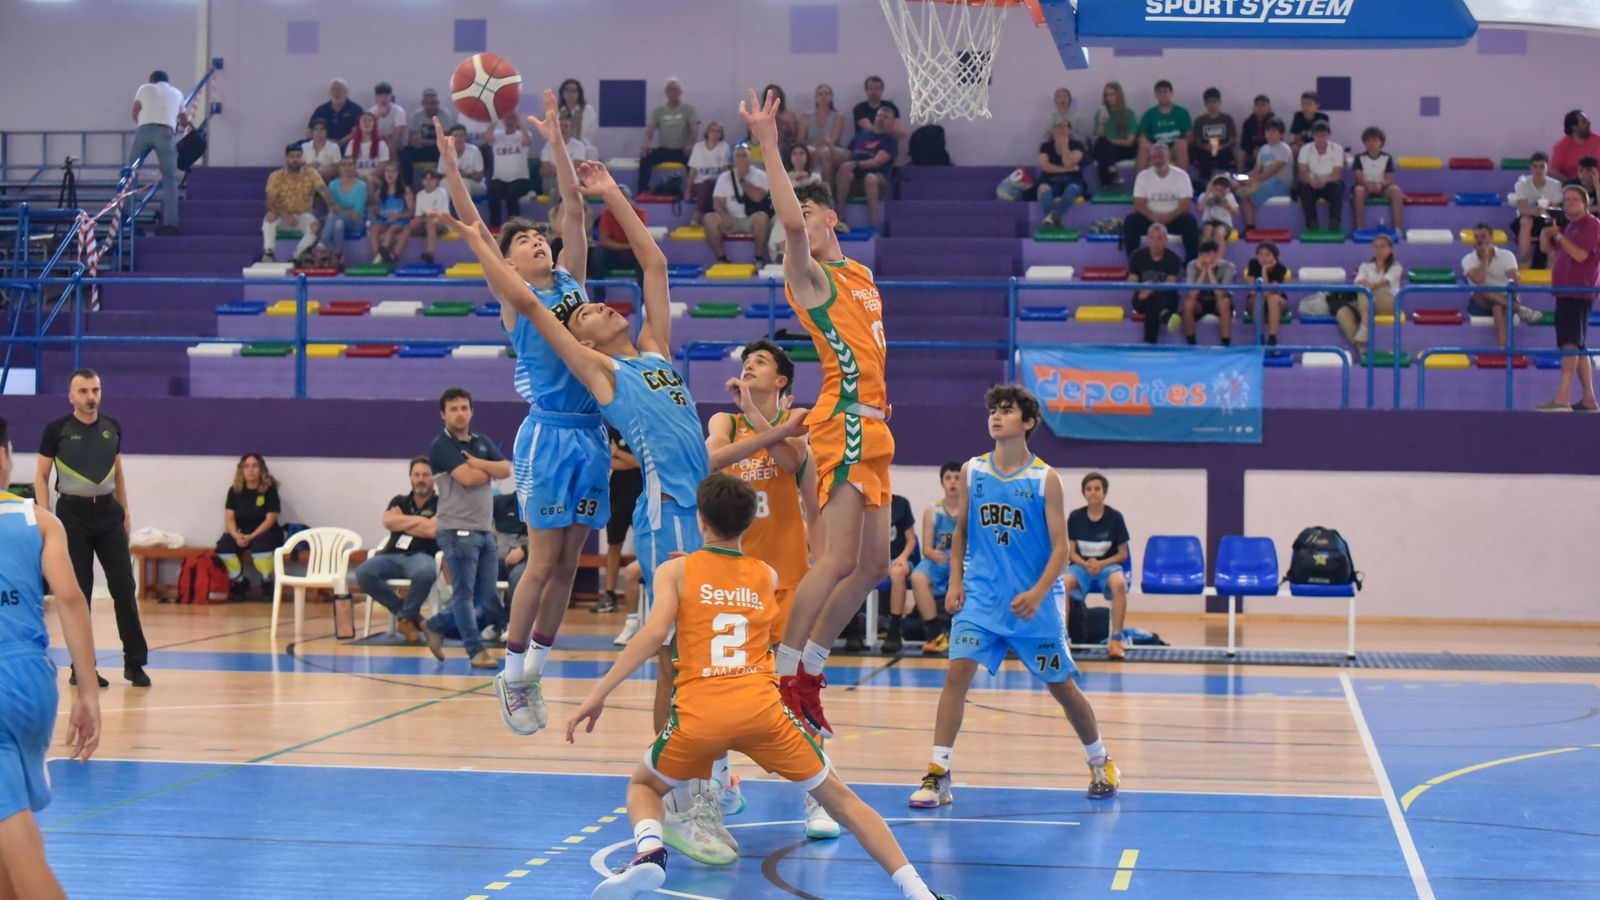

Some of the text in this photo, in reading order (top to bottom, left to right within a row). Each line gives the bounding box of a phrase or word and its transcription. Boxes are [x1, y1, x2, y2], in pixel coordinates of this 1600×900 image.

[740, 466, 778, 481] GREEN
[576, 497, 599, 518] 33
[979, 503, 1025, 532] CBCA
[711, 612, 748, 667] 2
[1036, 652, 1061, 673] 74
